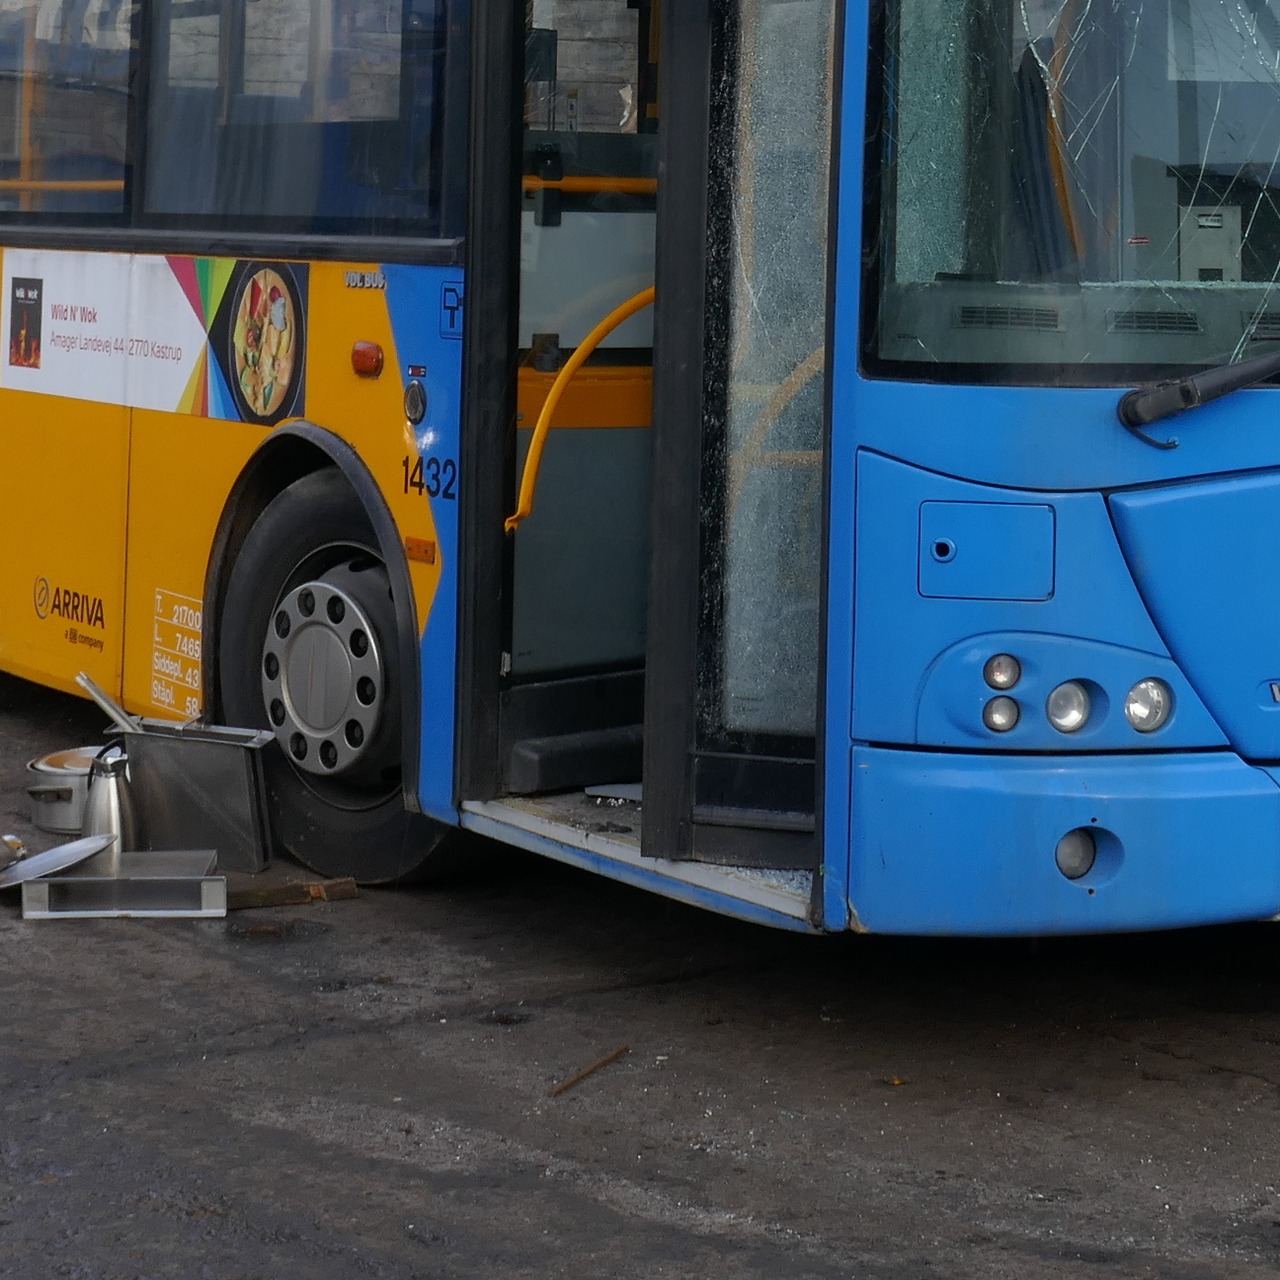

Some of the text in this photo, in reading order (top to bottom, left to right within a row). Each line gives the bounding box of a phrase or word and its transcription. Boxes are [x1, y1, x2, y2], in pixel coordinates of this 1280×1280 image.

[50, 303, 68, 321] Wild
[79, 306, 98, 324] Wok
[49, 330, 183, 365] Amager Landevej 44 2770 Kastrup
[402, 454, 458, 501] 1432
[50, 586, 106, 630] ARRIVA
[155, 594, 202, 631] T. 21700
[78, 632, 105, 654] company
[154, 623, 201, 658] L. 7465
[153, 651, 200, 688] Siddepl. 43
[152, 680, 199, 715] Ståpl. 58
